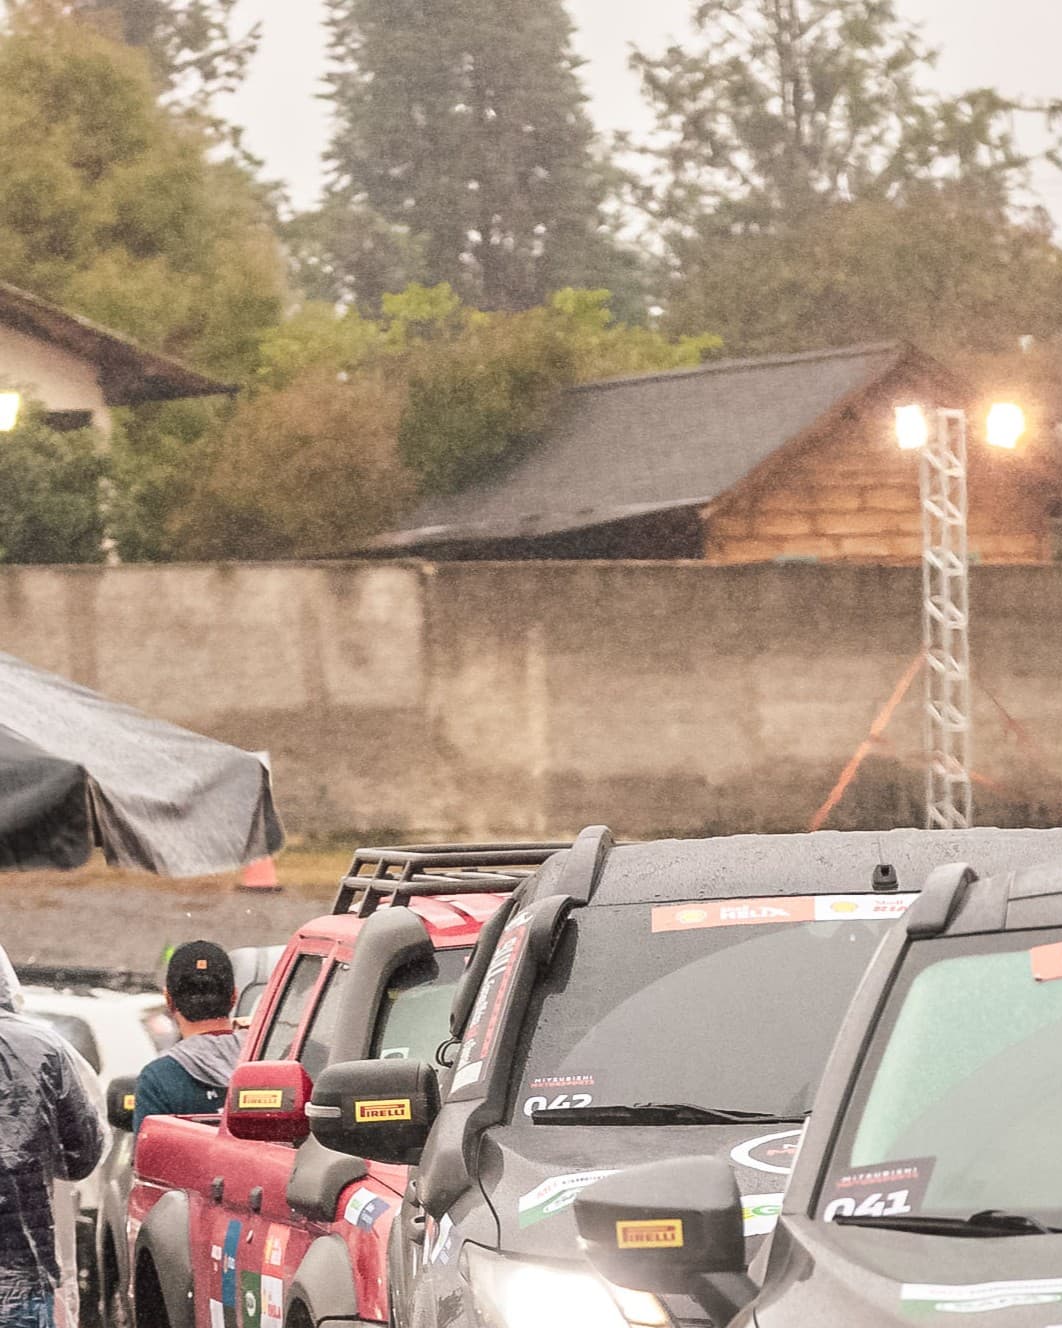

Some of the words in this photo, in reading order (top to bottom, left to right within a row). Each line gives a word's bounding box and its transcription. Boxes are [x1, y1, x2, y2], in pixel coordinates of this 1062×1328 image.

[359, 1103, 407, 1118] PIRELLI
[823, 1189, 911, 1223] 041
[621, 1225, 677, 1243] PIRELLI
